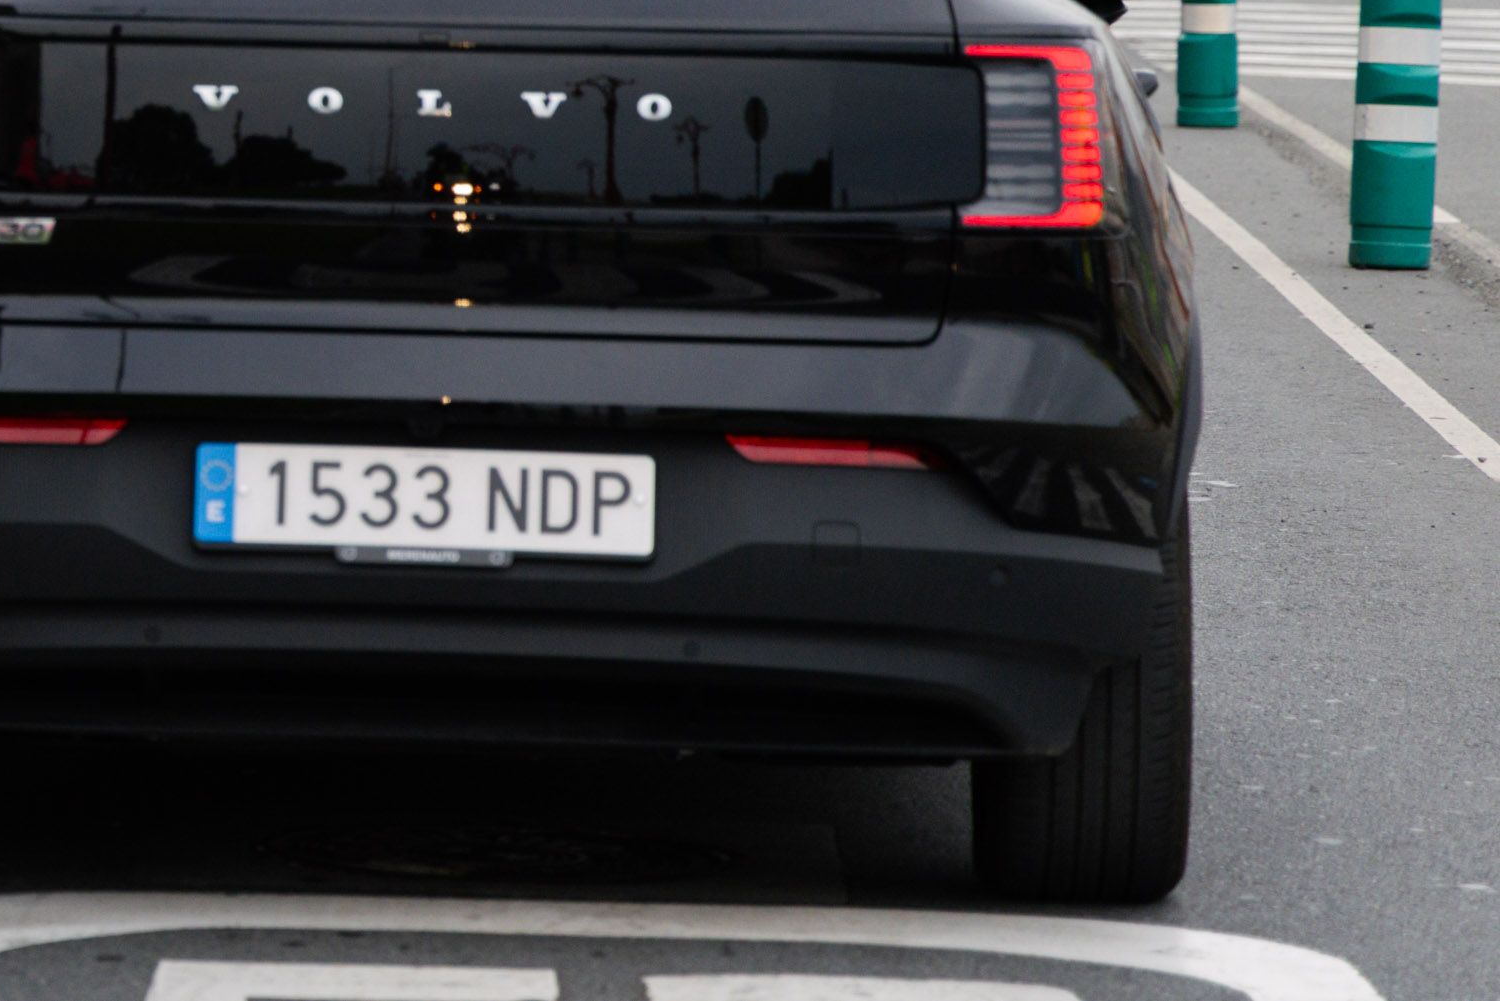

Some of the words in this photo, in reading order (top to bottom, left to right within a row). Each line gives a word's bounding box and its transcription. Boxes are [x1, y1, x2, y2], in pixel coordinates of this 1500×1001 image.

[193, 84, 672, 121] VOLVO
[206, 500, 225, 523] E
[270, 461, 450, 529] 1533
[488, 467, 631, 535] NDP
